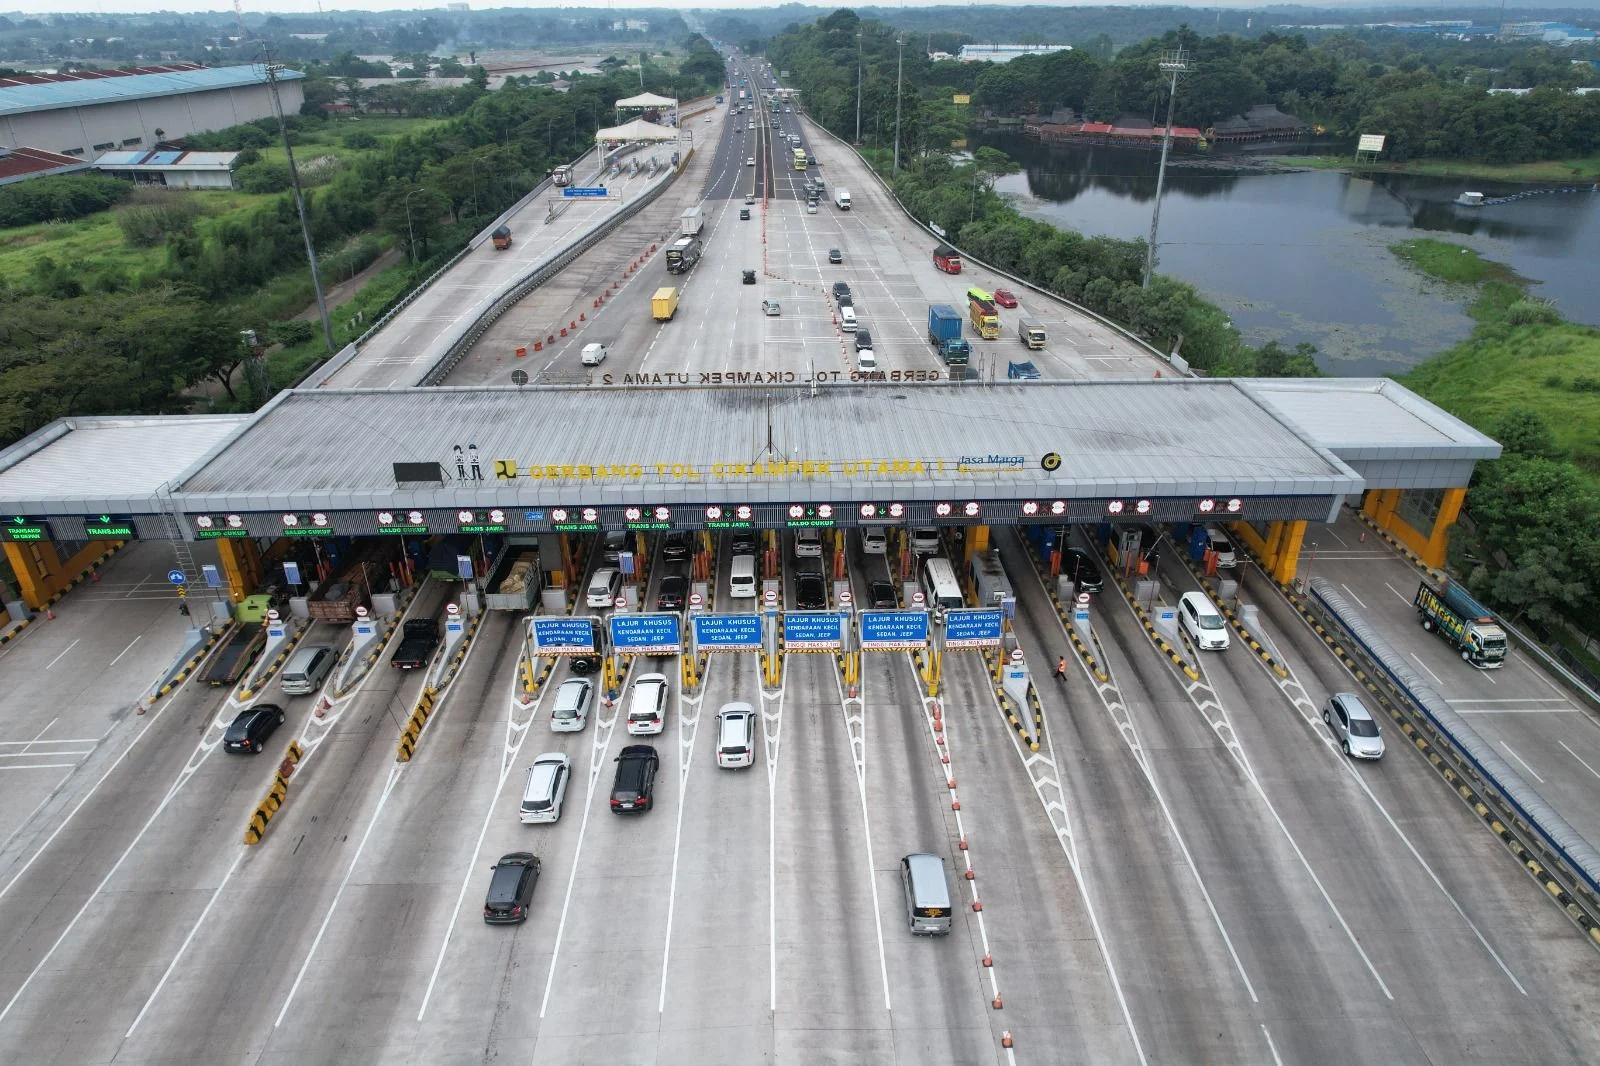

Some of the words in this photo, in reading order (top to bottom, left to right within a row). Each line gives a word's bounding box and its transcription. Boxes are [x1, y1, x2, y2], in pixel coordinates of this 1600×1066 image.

[529, 463, 643, 480] GERBANG
[654, 462, 700, 478] TOL
[712, 461, 832, 478] CIKAMPEK
[842, 458, 926, 475] UTAMA
[959, 455, 985, 465] Jasa
[987, 454, 1026, 467] Marga
